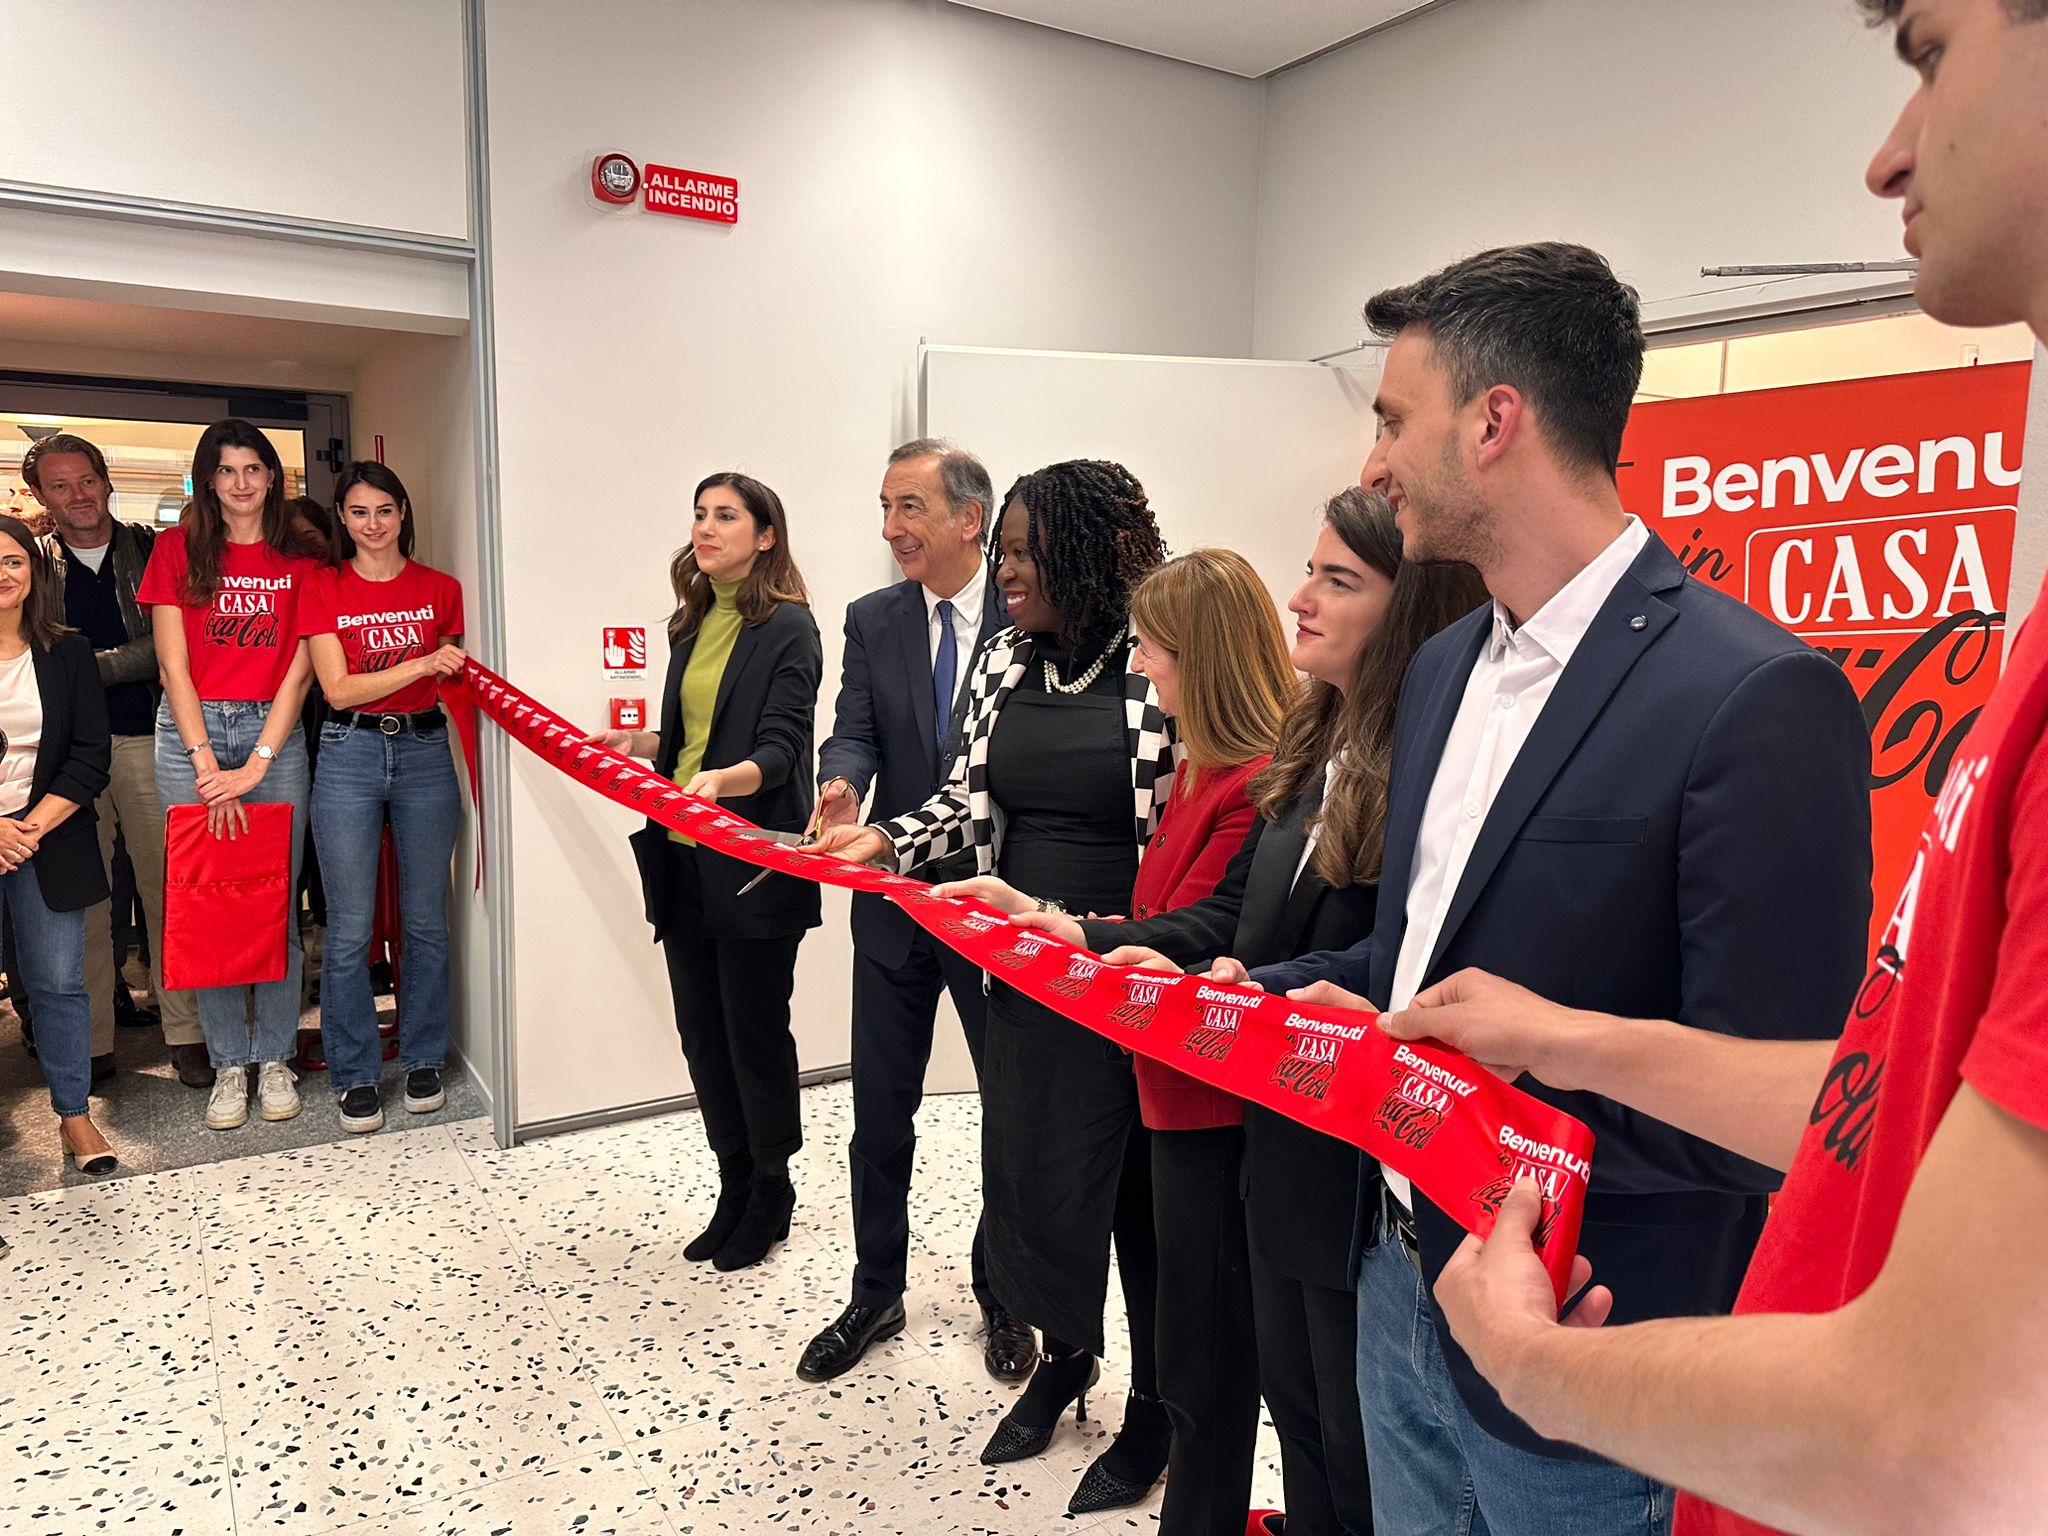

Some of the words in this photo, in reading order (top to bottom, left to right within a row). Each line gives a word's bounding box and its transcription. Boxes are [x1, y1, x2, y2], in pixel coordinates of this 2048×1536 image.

[650, 173, 734, 199] ALLARME
[648, 189, 735, 215] INCENDIO
[1662, 431, 2023, 518] Benvenu
[222, 574, 291, 590] nvenuti
[1769, 524, 2001, 625] CASA
[219, 593, 268, 613] CASA
[337, 604, 434, 629] Benvenuti
[368, 625, 420, 649] CASA
[1014, 940, 1041, 956] CASA
[1068, 961, 1098, 979] CASA
[1130, 984, 1159, 1004] CASA
[1196, 985, 1266, 1009] Benvenuti
[1205, 1007, 1238, 1029] CASA
[1284, 1012, 1368, 1041] Benvenuti
[1297, 1036, 1336, 1062] CASA
[1393, 1044, 1478, 1097] Benvenuti
[1402, 1075, 1449, 1112] CASA
